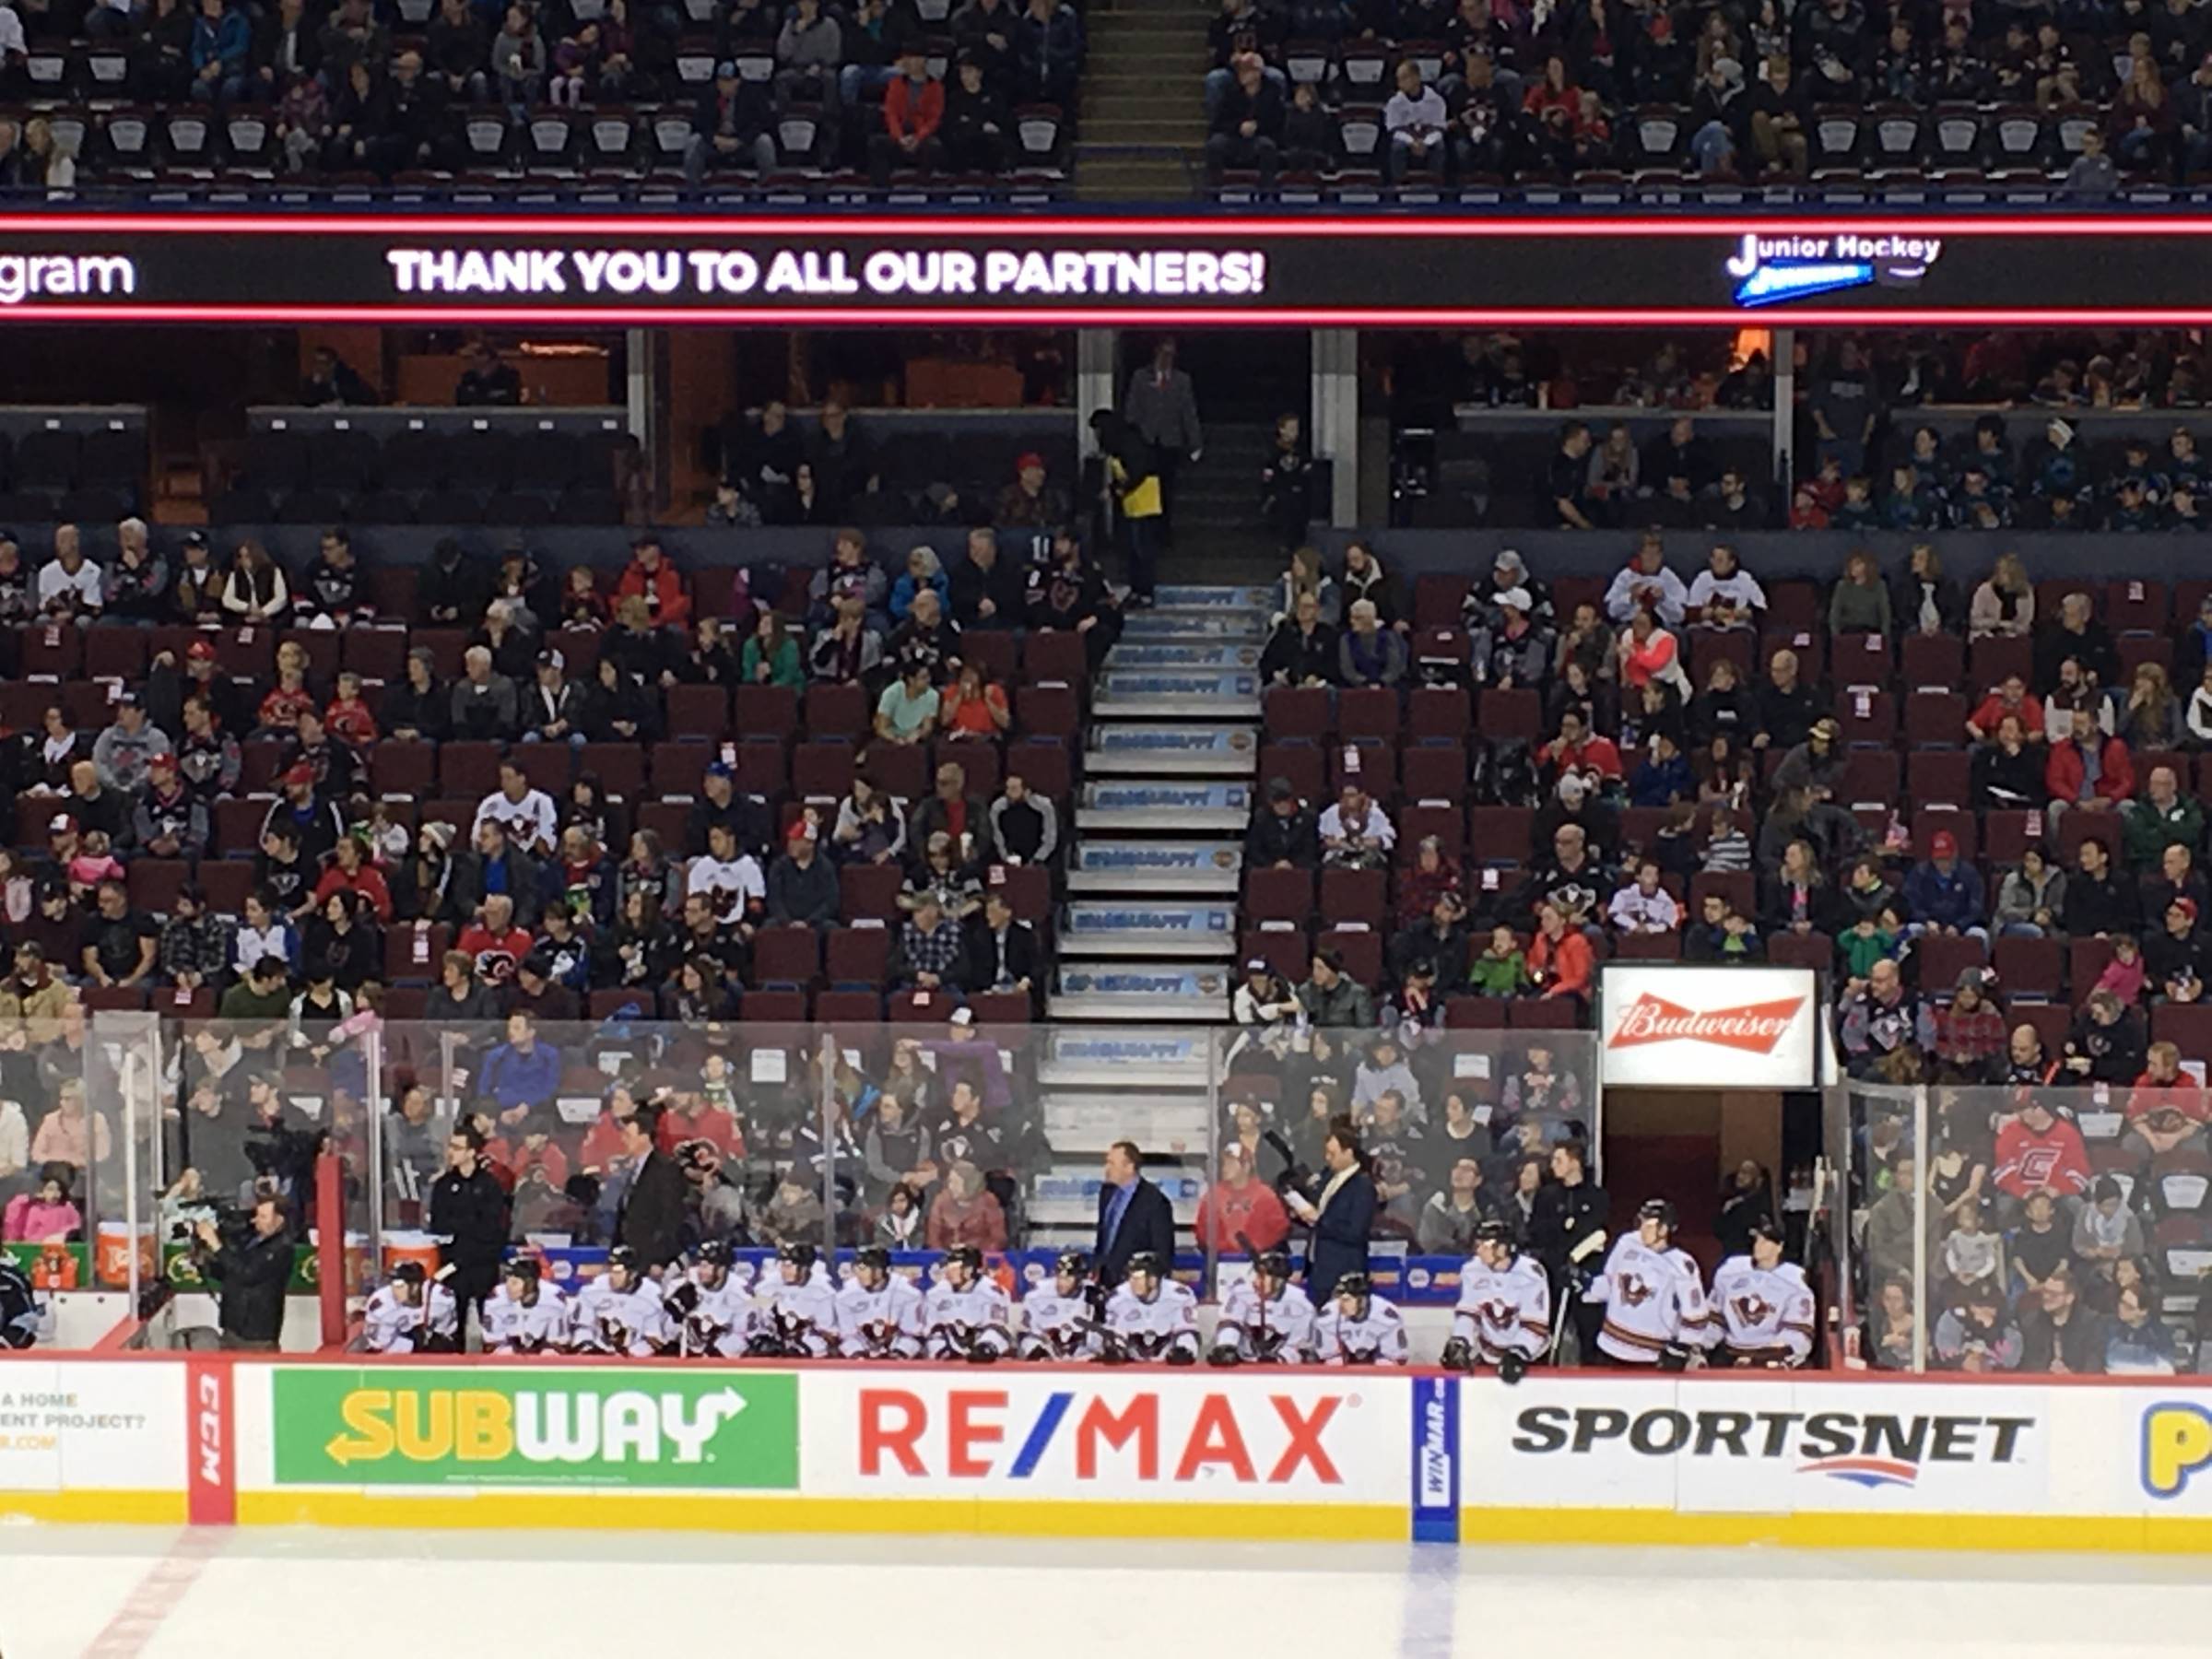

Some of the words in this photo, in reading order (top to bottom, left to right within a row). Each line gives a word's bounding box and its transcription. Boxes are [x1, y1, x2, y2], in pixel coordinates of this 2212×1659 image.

[387, 251, 566, 292] THANK
[573, 251, 681, 292] YOU
[688, 251, 758, 293] TO
[764, 251, 859, 293] ALL
[865, 252, 977, 293] OUR
[985, 252, 1265, 293] PARTNERS!
[1726, 233, 1830, 276] Junior
[1835, 235, 1941, 264] Hockey
[1616, 1001, 1795, 1038] Budweiser
[20, 1393, 77, 1407] HOME
[44, 1413, 146, 1430] PROJECT?
[200, 1373, 219, 1485] CCM
[325, 1386, 748, 1465] SUBWAY
[859, 1389, 1344, 1483] RE/MAX
[1512, 1406, 2034, 1464] SPORTSNET
[2141, 1401, 2212, 1500] P
